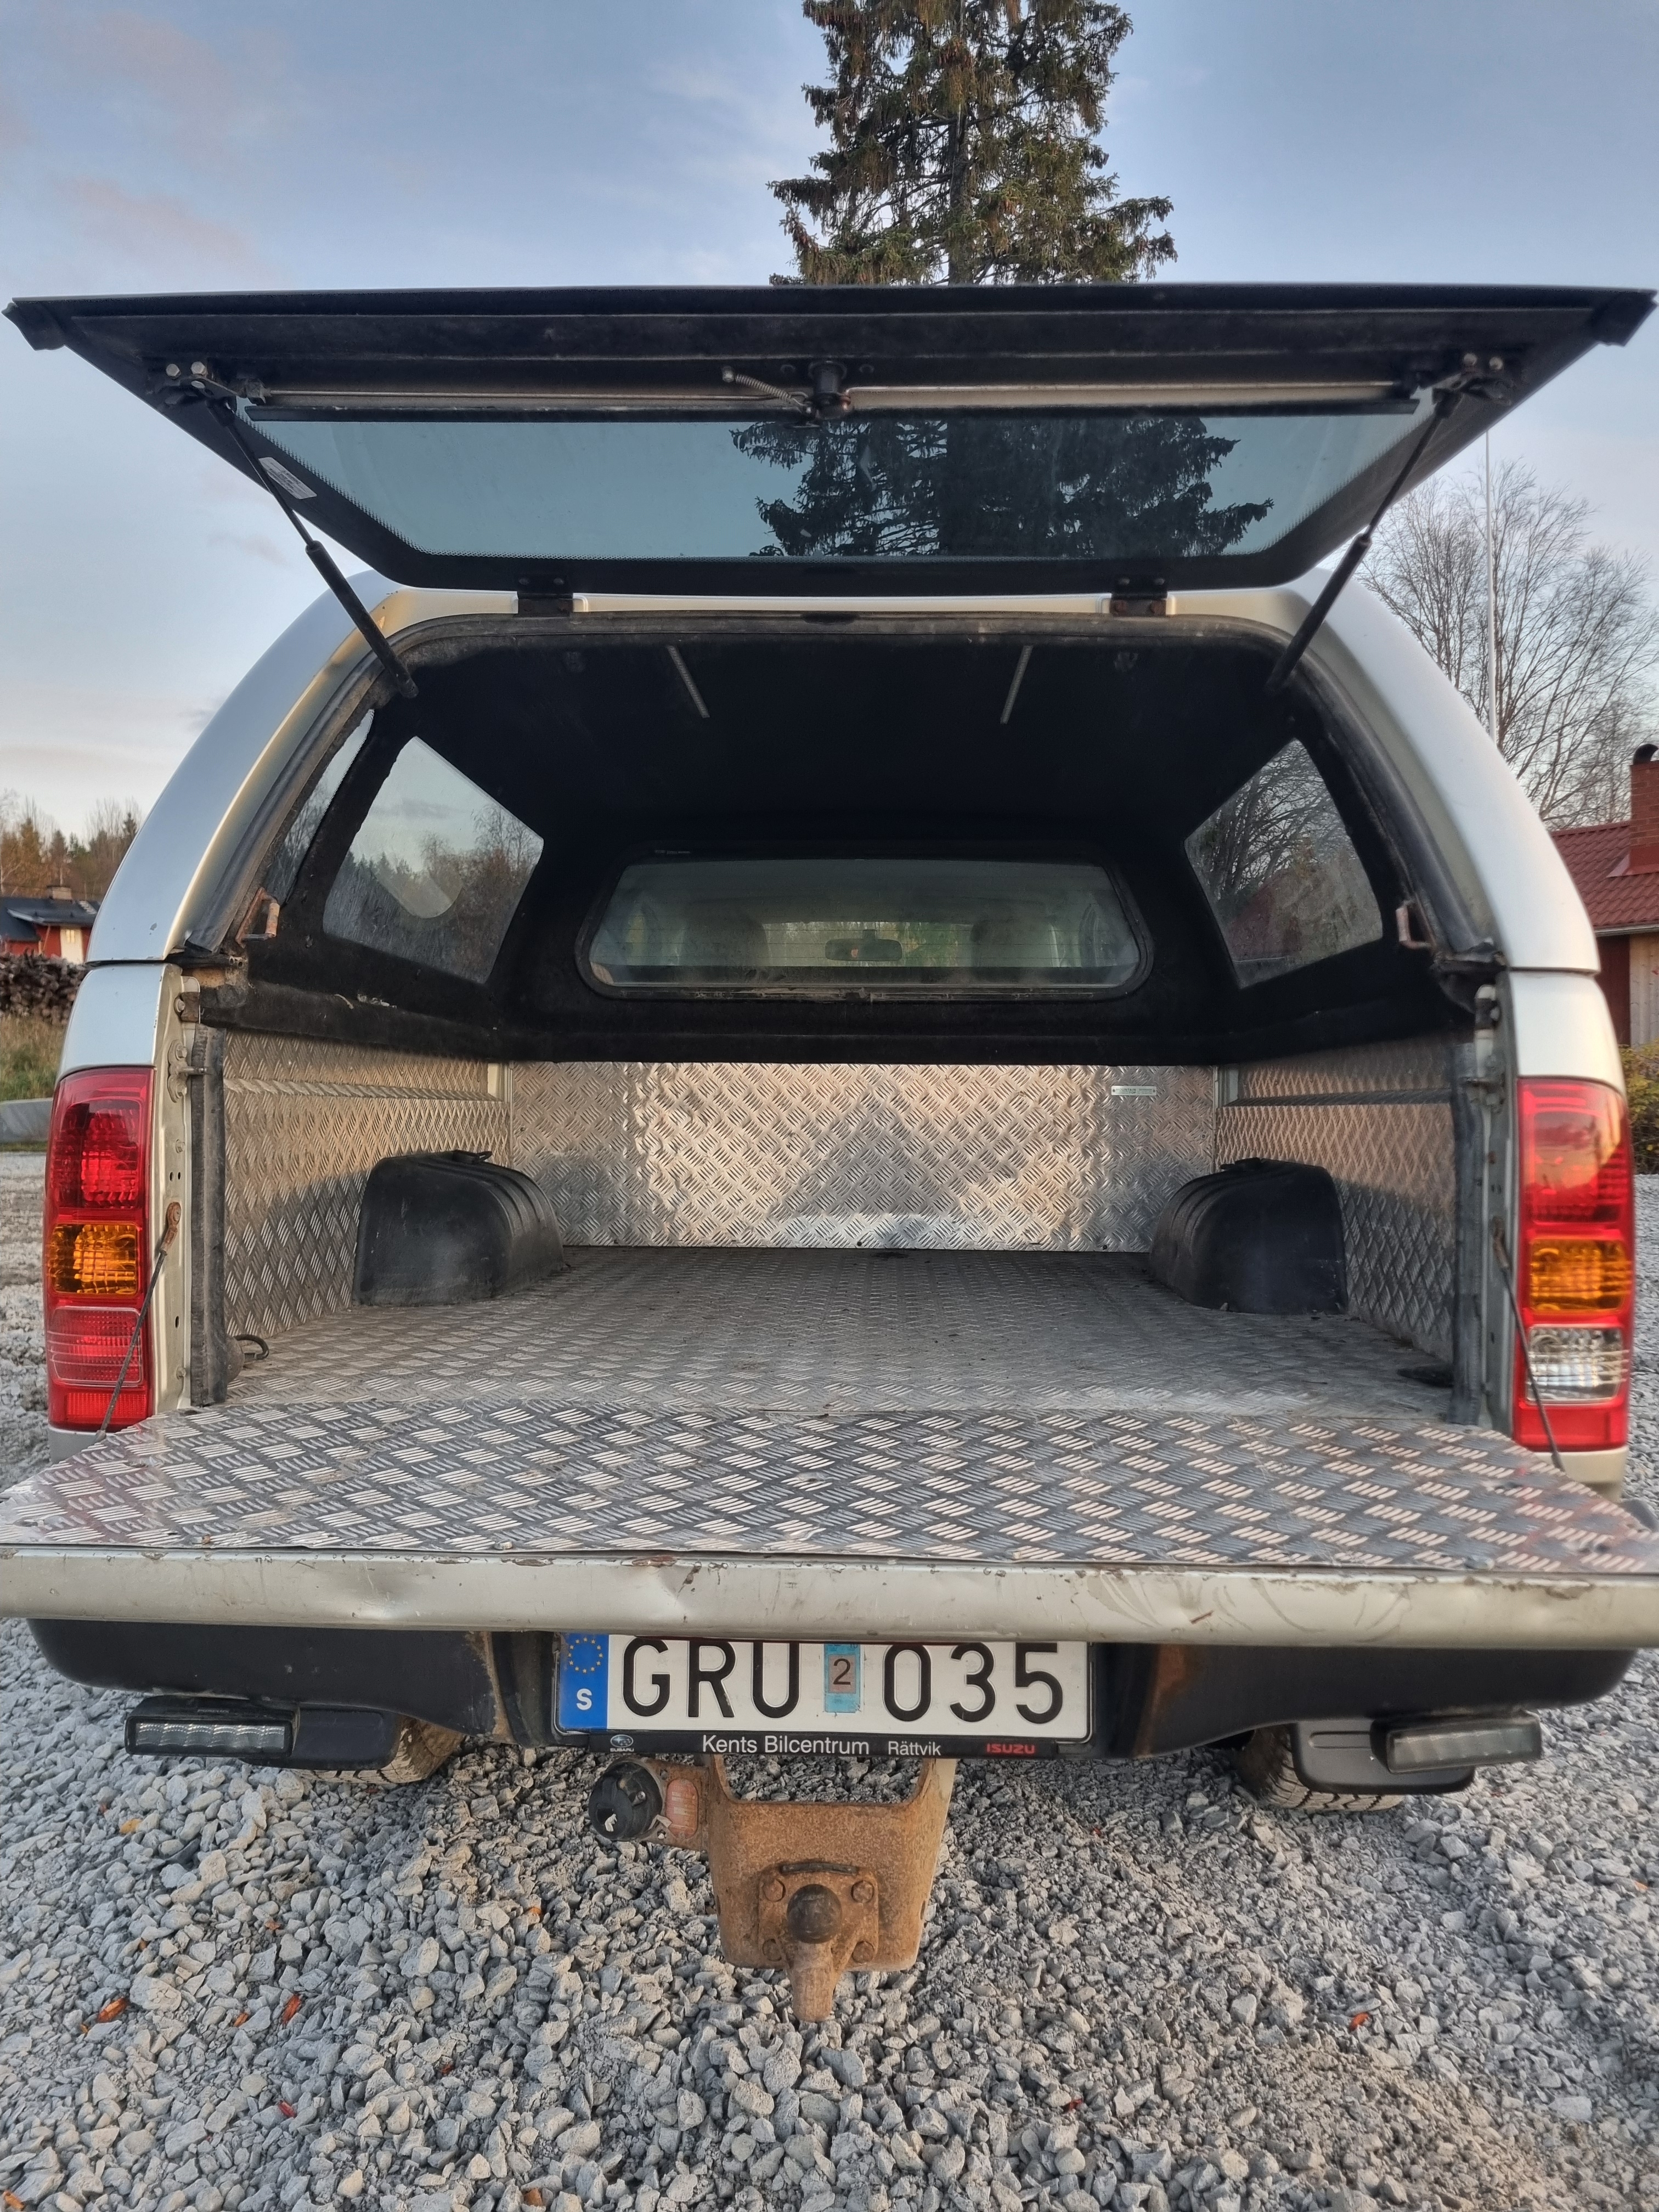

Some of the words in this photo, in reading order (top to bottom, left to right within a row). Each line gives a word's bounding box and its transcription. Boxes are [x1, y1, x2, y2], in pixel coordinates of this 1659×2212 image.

[623, 1637, 800, 1719] GRU
[884, 1642, 1063, 1724] 035
[833, 1658, 851, 1685] 2
[576, 1688, 592, 1711] S
[702, 1734, 757, 1753] Kents
[765, 1735, 870, 1755] Bilcentrum
[888, 1740, 941, 1756] Rättvik
[987, 1743, 1035, 1754] ISUZU
